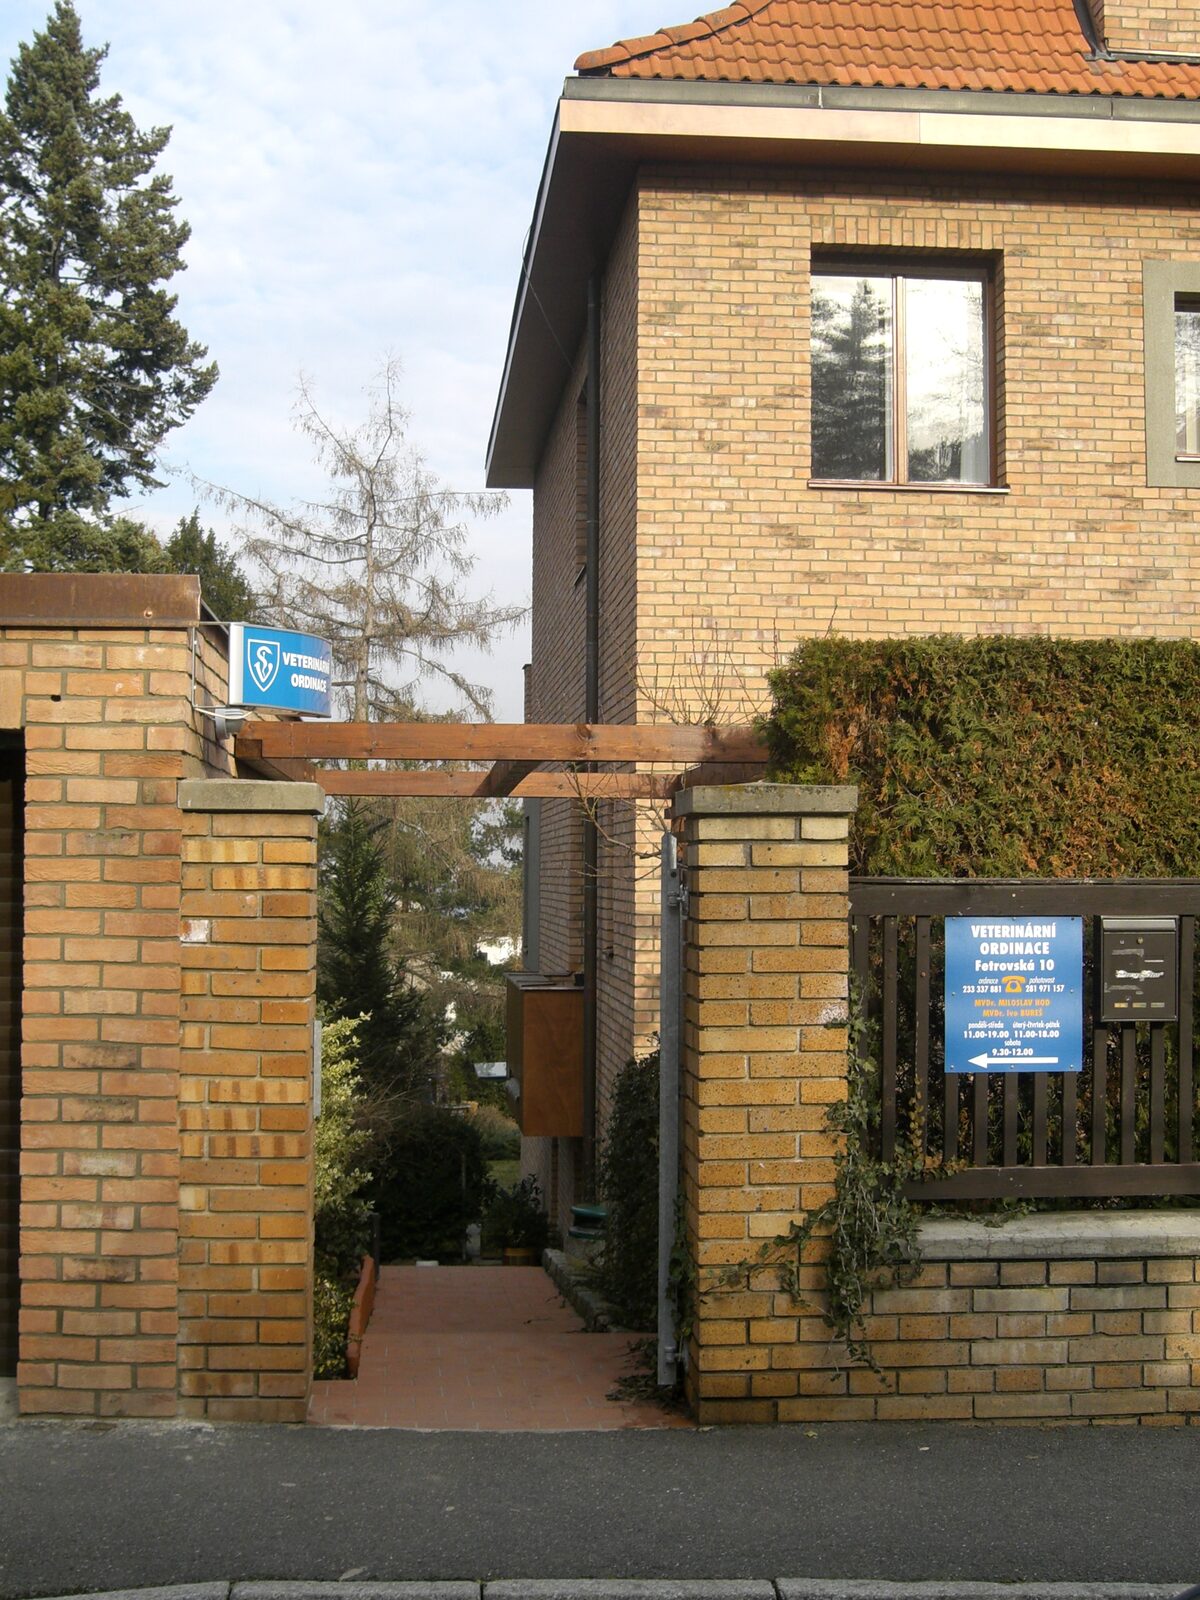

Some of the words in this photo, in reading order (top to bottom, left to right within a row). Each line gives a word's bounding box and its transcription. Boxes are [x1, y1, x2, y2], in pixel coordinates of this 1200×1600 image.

[290, 673, 327, 693] ORDINACE
[970, 922, 1057, 938] VETERINÁRNÍ
[979, 942, 1050, 955] ORDINACE
[974, 959, 1035, 972] Fetrovská
[1039, 959, 1055, 971] 10
[978, 977, 999, 985] ordinace
[962, 985, 975, 993] 233
[976, 985, 988, 993] 337
[1025, 984, 1037, 993] 281
[1038, 984, 1050, 993] 971
[1053, 984, 1065, 992] 157
[974, 999, 996, 1007] MVDr.
[998, 999, 1033, 1007] MILOSLAV
[982, 1009, 1004, 1017] MVDr.
[963, 1030, 1009, 1039] 11.00-19.00
[1014, 1030, 1060, 1038] 11.00-18.00
[1004, 1038, 1021, 1046] sobota
[991, 1048, 1034, 1056] 9.30-12.00
